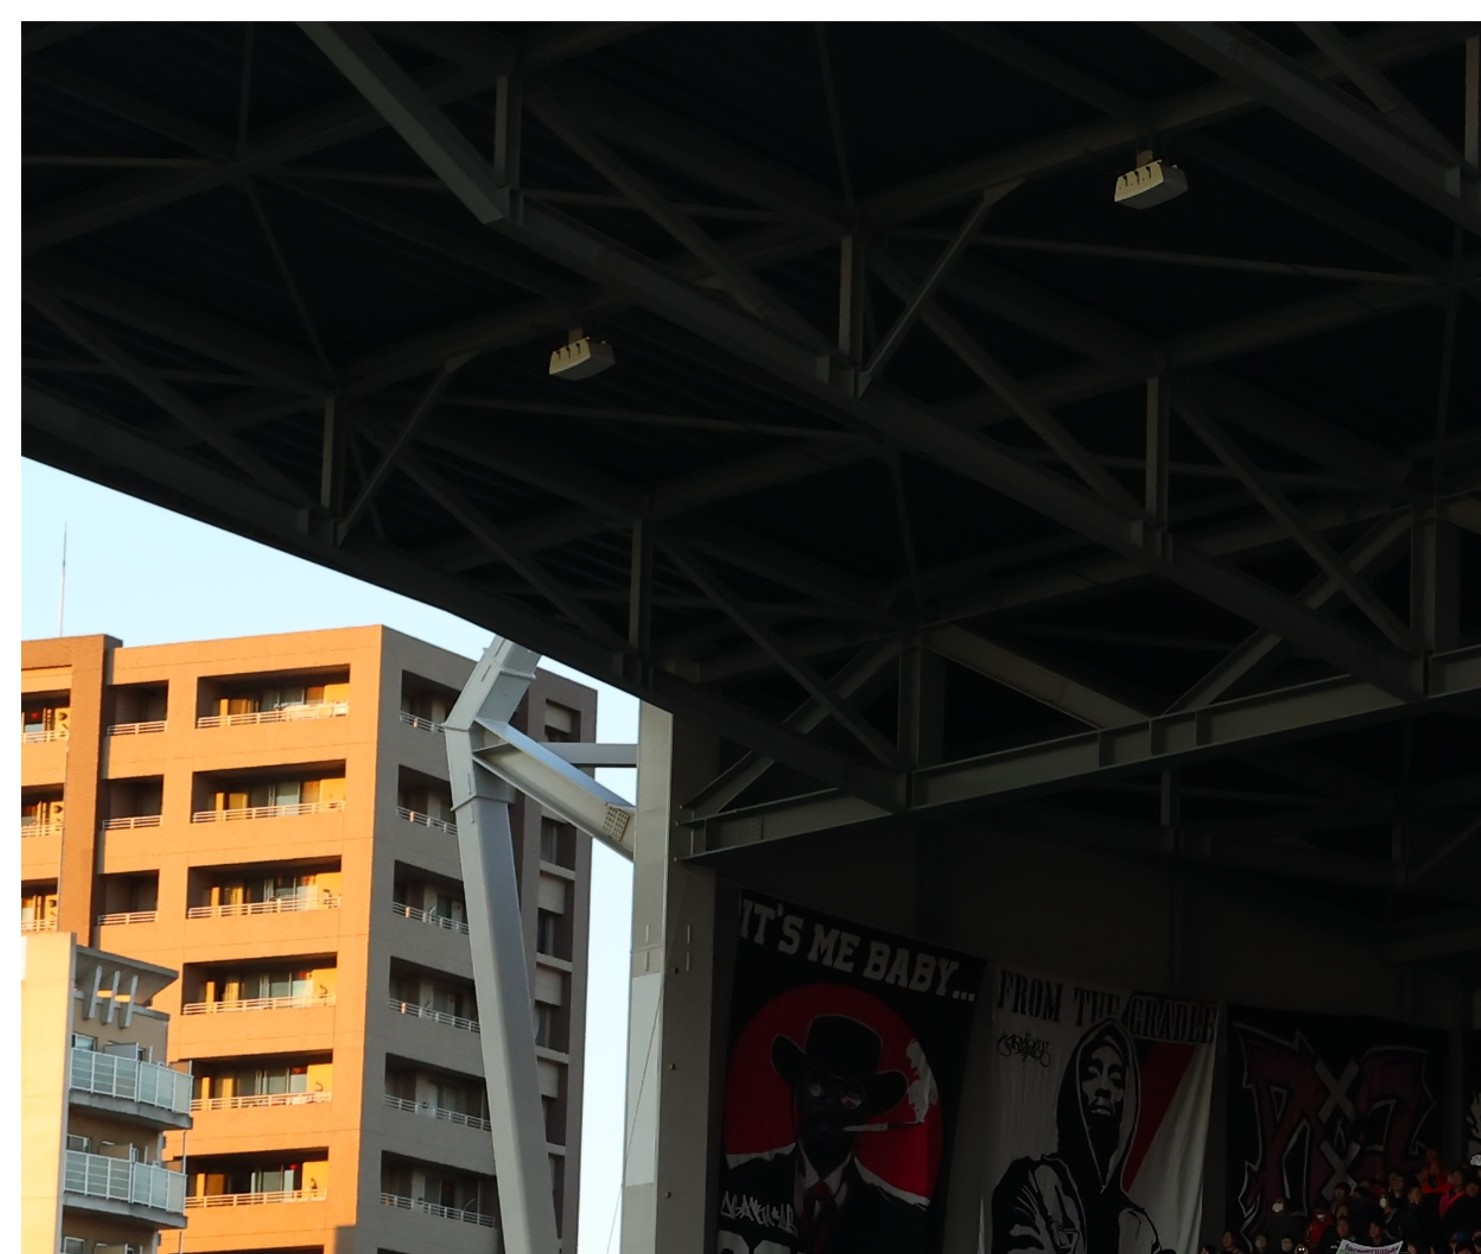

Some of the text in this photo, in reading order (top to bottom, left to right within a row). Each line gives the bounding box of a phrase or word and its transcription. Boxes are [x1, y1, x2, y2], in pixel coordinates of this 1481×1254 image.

[741, 900, 804, 956] IT'S
[807, 923, 862, 975] ME
[997, 970, 1064, 1022] FROM
